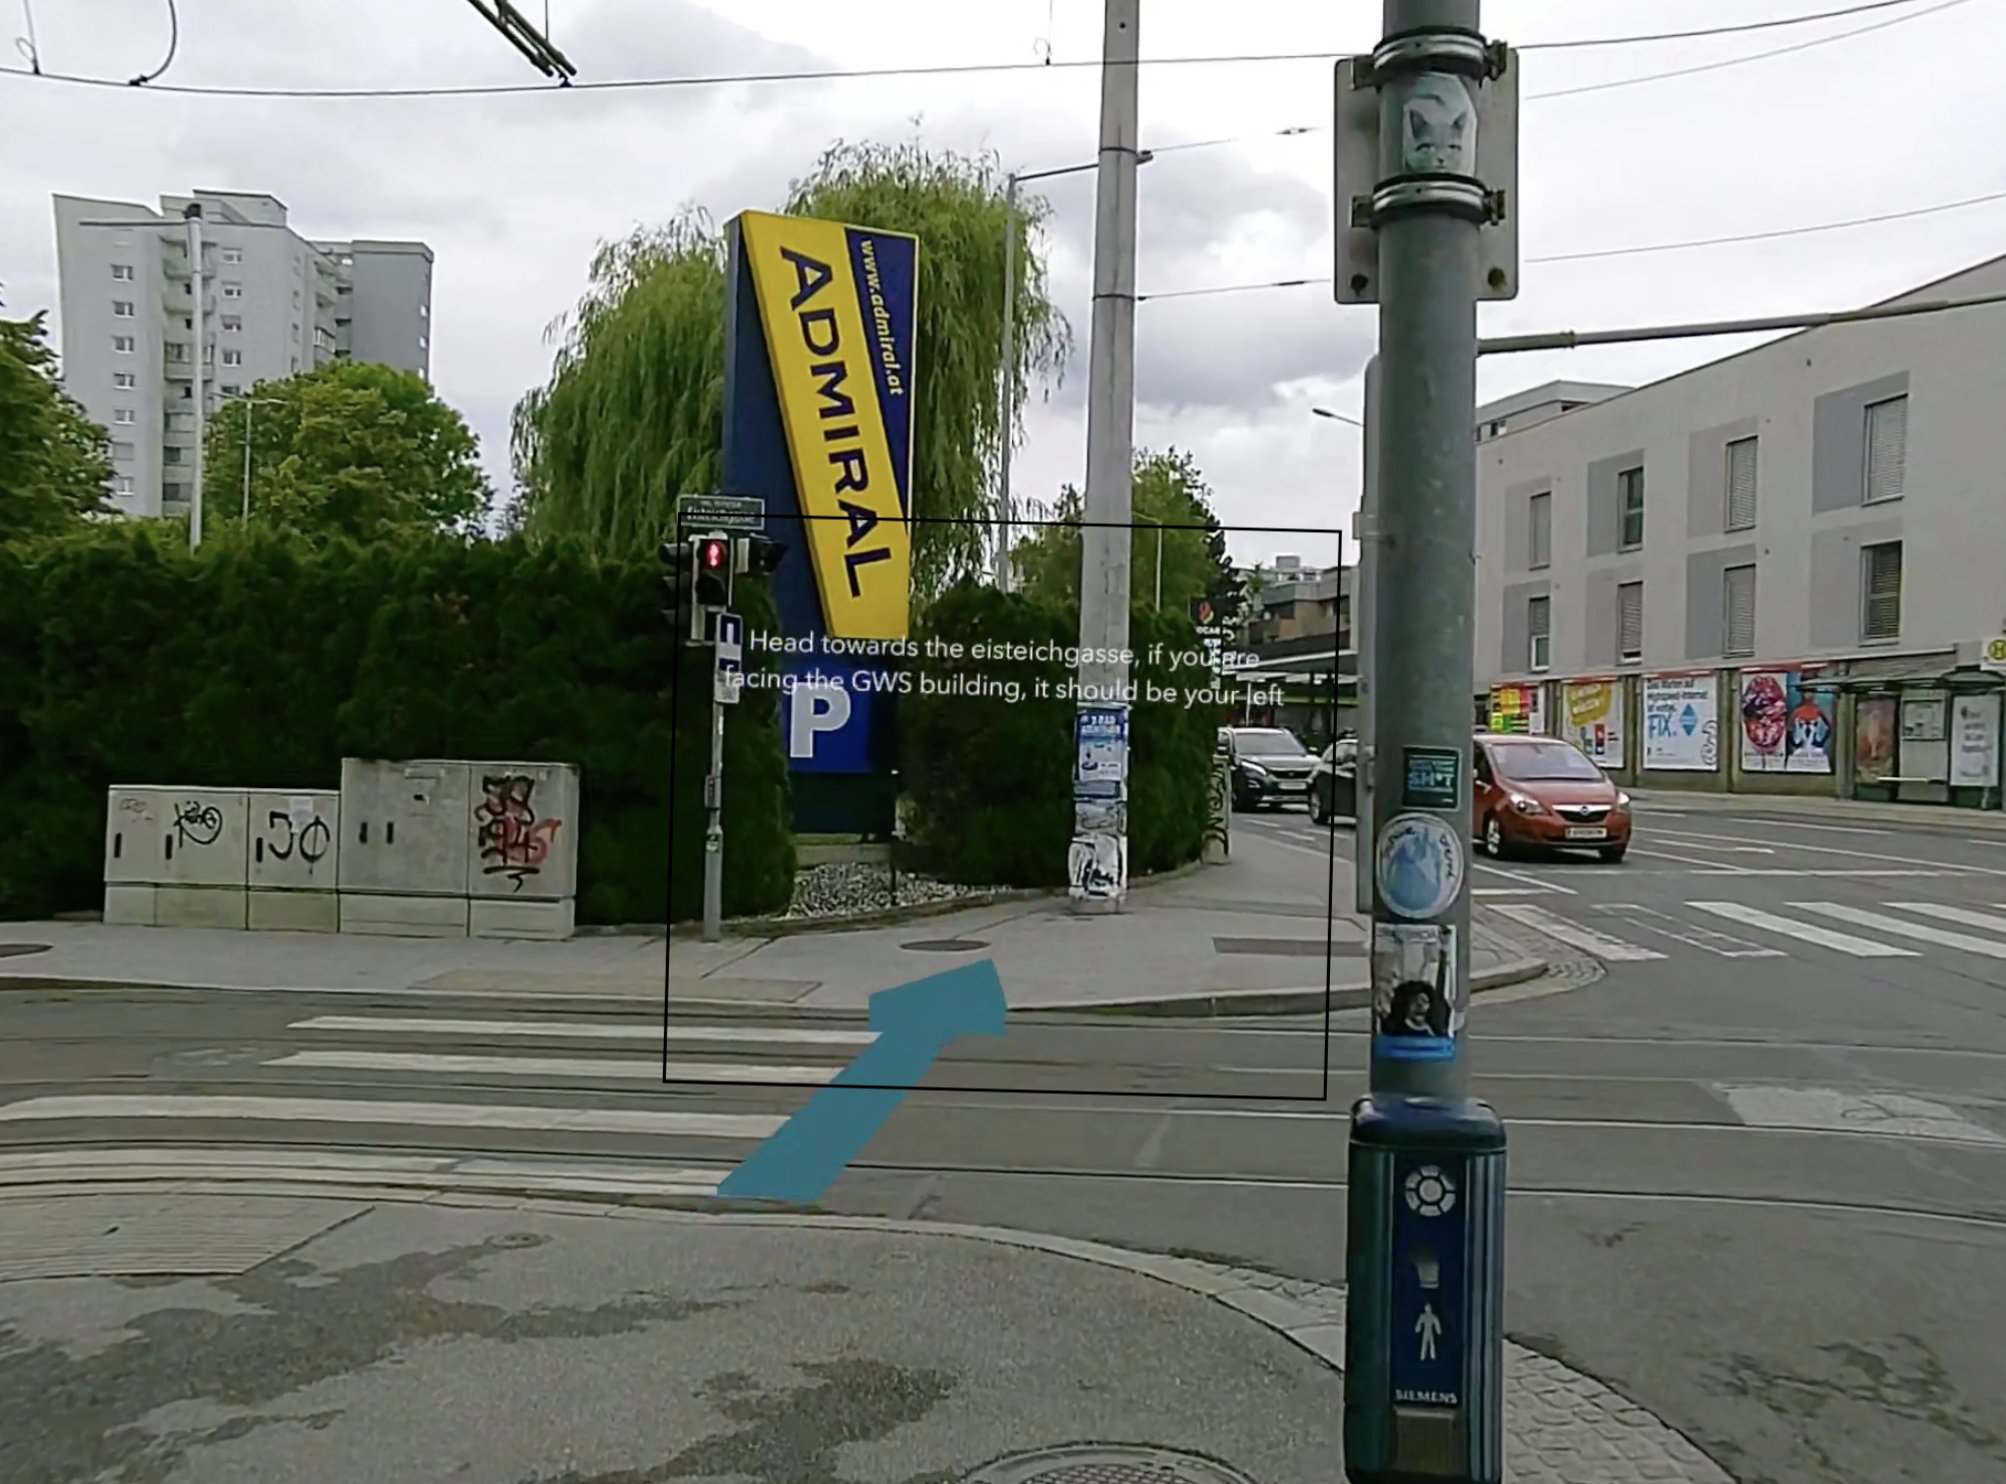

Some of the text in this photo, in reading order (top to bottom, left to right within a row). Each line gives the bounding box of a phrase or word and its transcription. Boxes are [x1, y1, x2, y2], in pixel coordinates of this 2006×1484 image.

[860, 238, 904, 396] www.admiral.at
[779, 246, 892, 600] ADMIRAL
[1195, 625, 1221, 636] OCAR
[789, 681, 851, 758] P
[1395, 1388, 1458, 1404] SIEMENS
